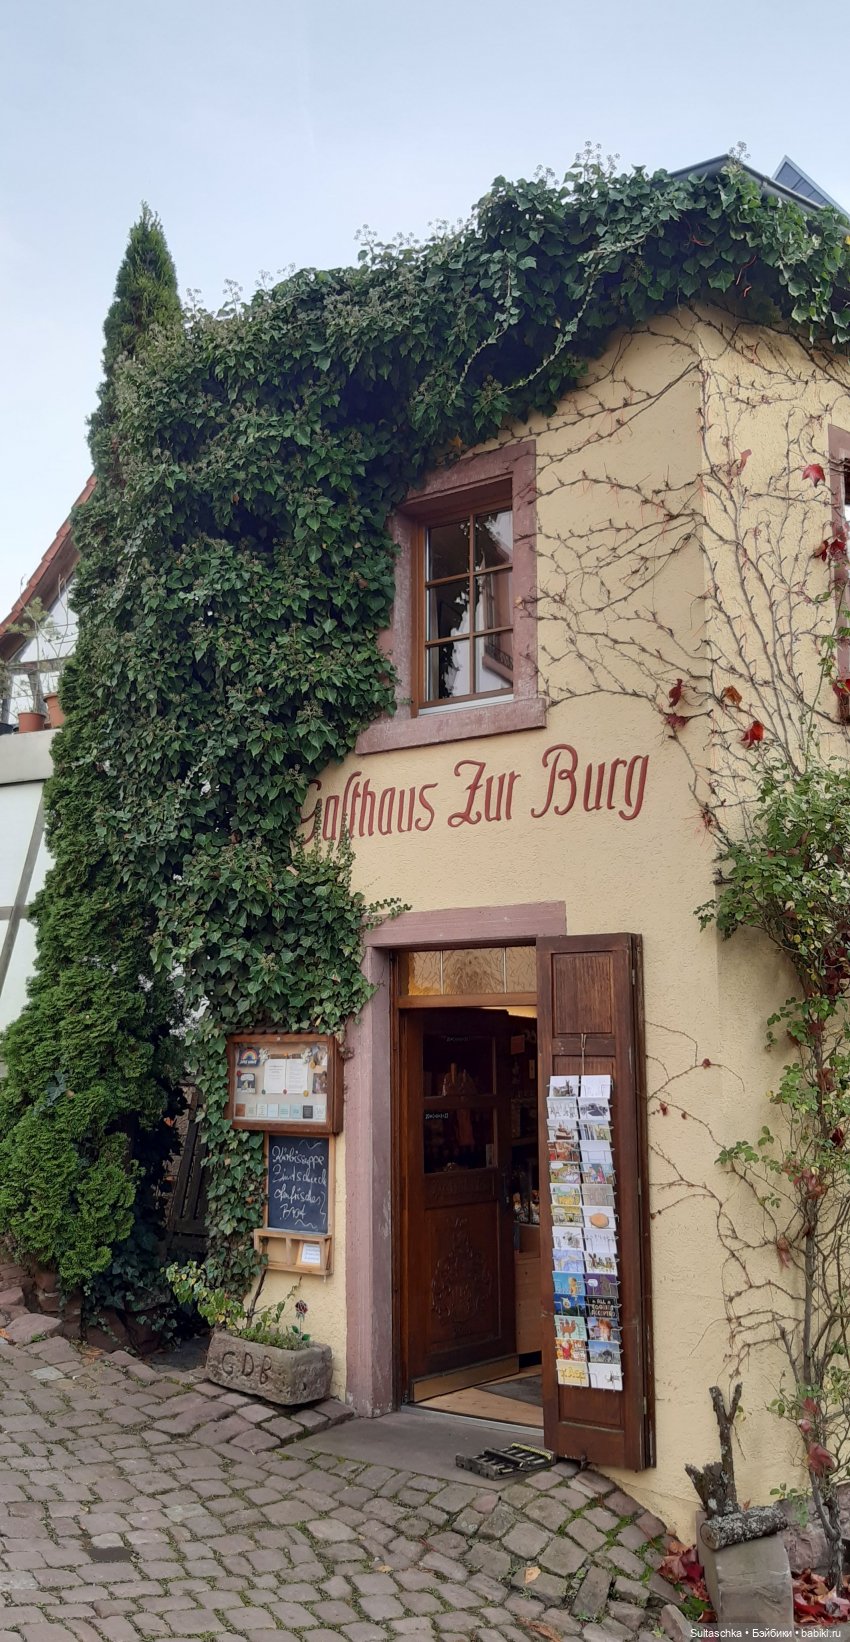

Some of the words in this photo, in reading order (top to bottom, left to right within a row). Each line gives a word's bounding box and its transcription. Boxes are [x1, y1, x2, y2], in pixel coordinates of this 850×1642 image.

[447, 759, 521, 828] Zur
[530, 743, 650, 822] Burg
[280, 1203, 306, 1219] Brot
[221, 1350, 273, 1385] GDB
